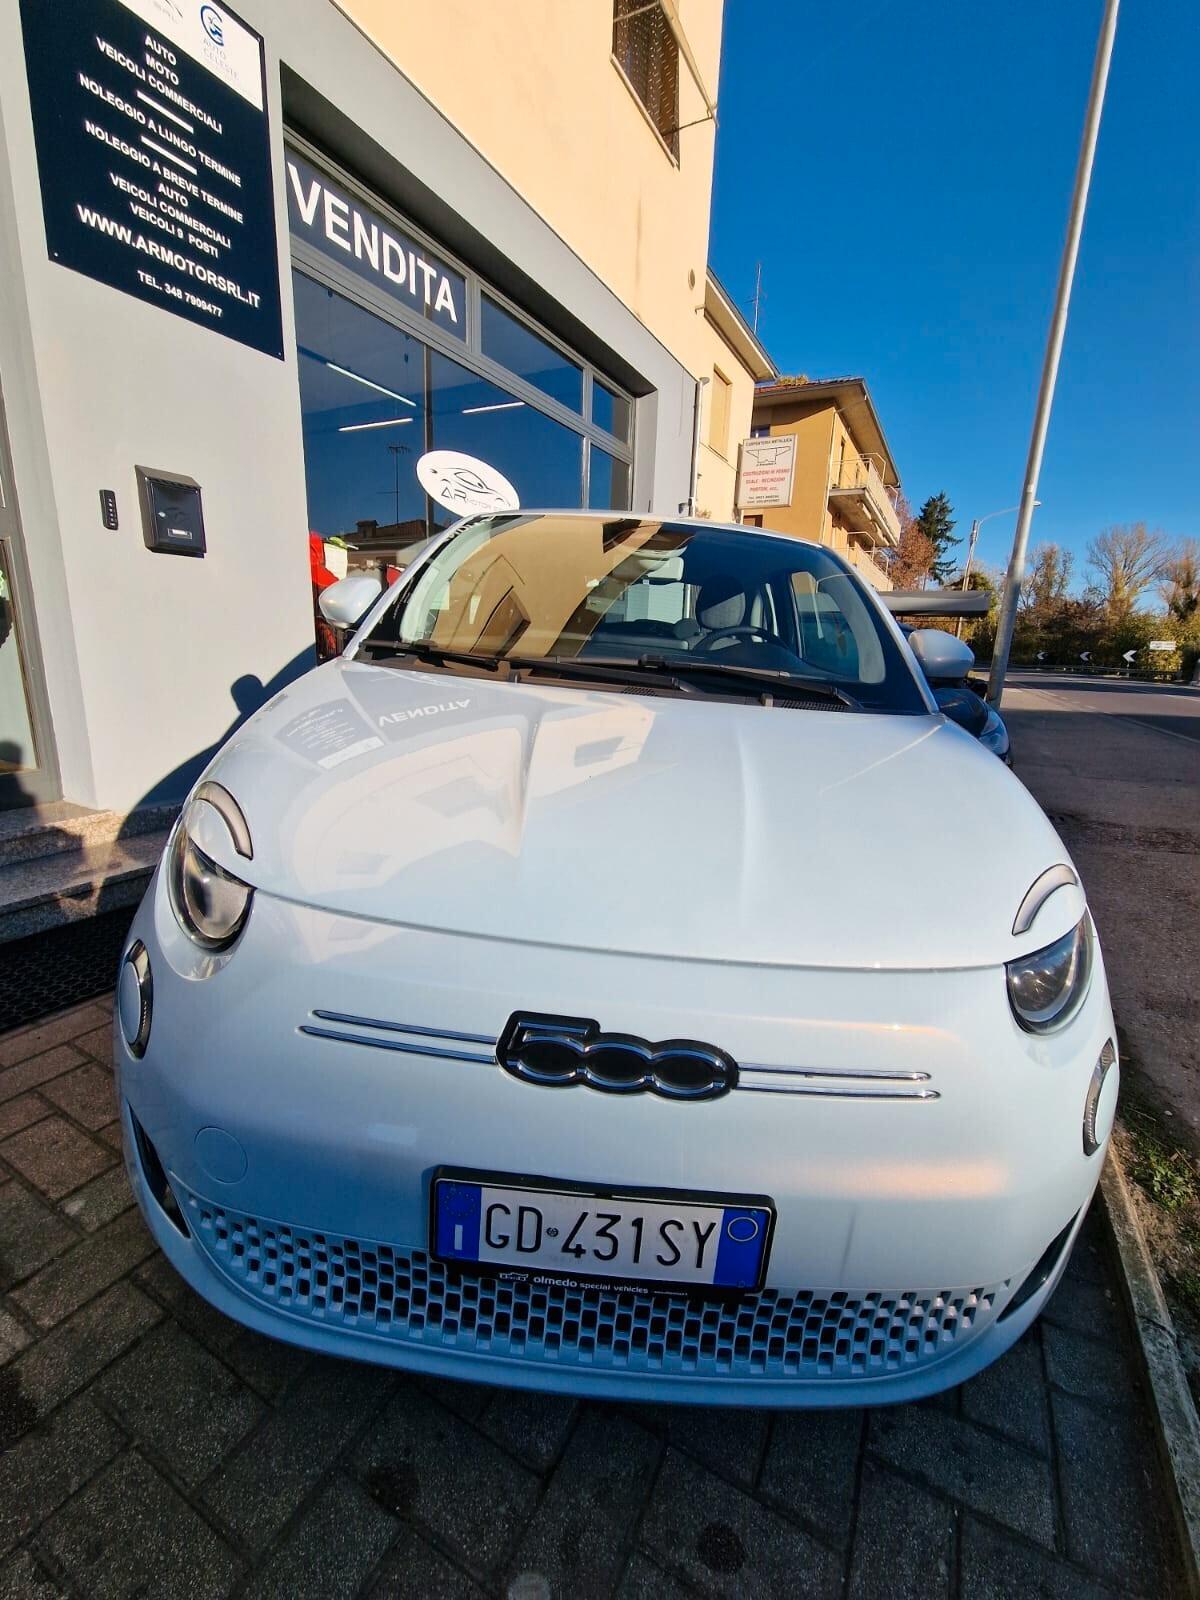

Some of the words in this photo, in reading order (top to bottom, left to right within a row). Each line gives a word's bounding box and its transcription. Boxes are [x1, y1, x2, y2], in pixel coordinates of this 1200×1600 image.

[96, 36, 146, 81] VEICOLI
[148, 74, 223, 134] COMMERCIALI
[145, 35, 176, 65] AUTO
[145, 53, 179, 85] MOTO
[79, 73, 146, 124] NOLEGGIO
[148, 119, 156, 132] A
[158, 125, 197, 157] LUNGO
[198, 150, 242, 187] TERMINE
[85, 120, 150, 167] NOLEGGIO
[152, 161, 162, 174] A
[163, 167, 199, 197] BREVE
[201, 190, 243, 224] TERMINE
[110, 172, 157, 208] VEICOLI
[159, 203, 231, 248] COMMERCIALI
[158, 183, 188, 207] AUTO
[77, 204, 260, 308] WWW.ARMOTORSRL.IT
[130, 202, 175, 235] VEICOLI
[177, 227, 184, 239] 9
[188, 233, 218, 258] POSTI
[288, 161, 458, 323] VENDITA
[137, 270, 163, 291] TEL.
[164, 283, 182, 299] 348
[497, 1012, 737, 1099] 500
[533, 1276, 577, 1288] olmedo
[579, 1282, 611, 1291] special
[613, 1285, 649, 1294] vehicles
